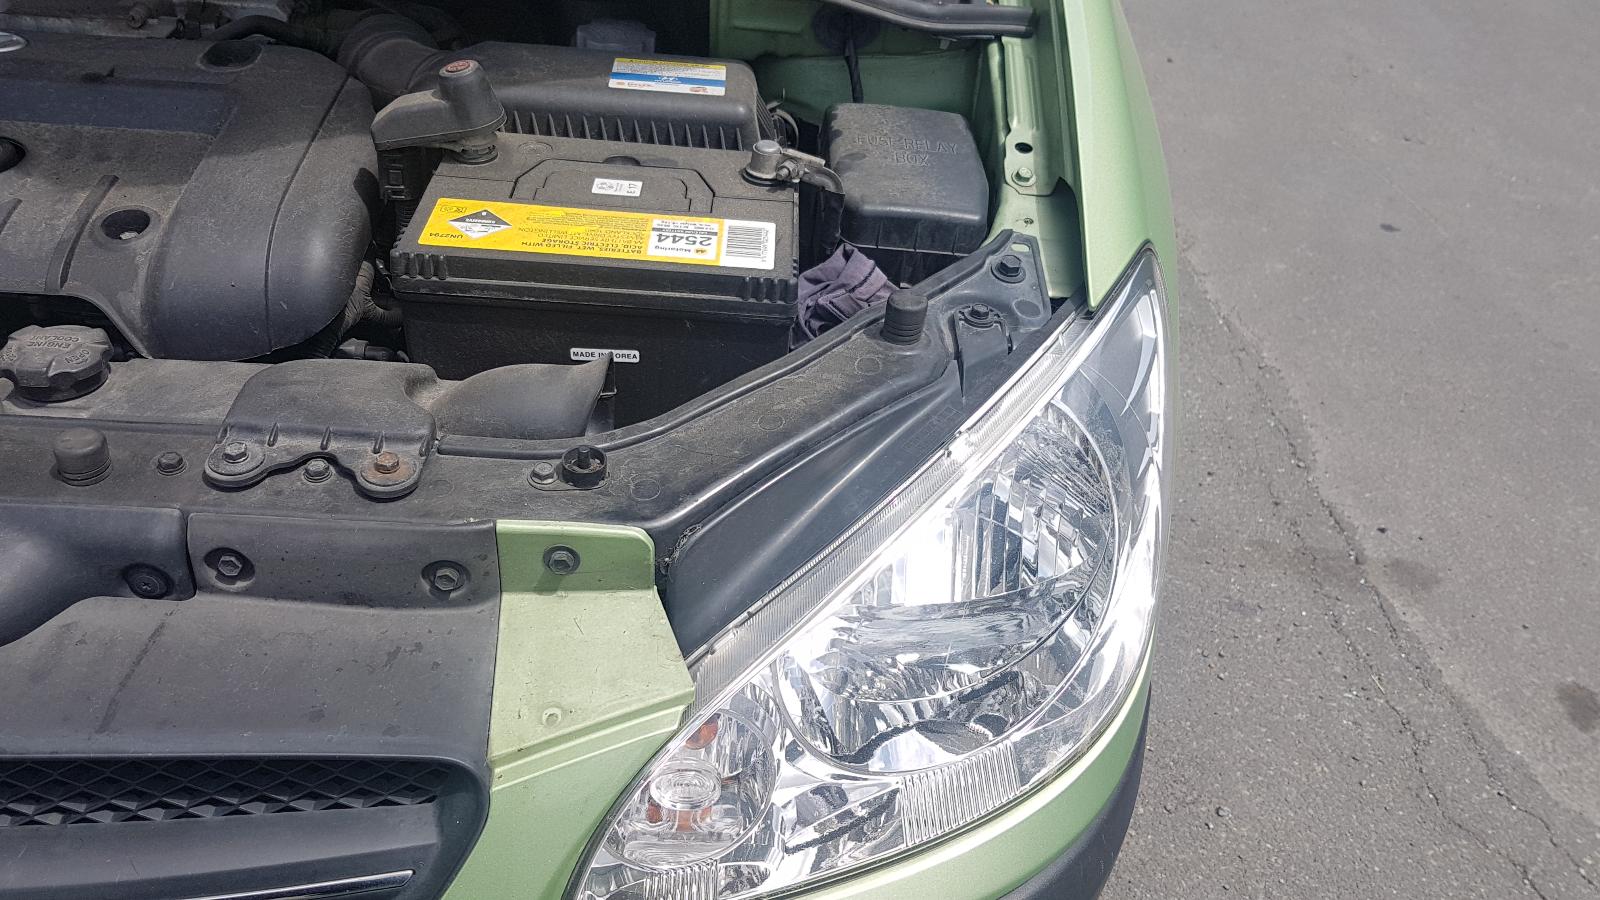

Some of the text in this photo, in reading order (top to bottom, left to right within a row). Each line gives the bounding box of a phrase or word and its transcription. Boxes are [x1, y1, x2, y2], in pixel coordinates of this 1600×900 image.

[854, 134, 957, 154] FUSE RELAY
[894, 152, 929, 167] BOX
[656, 233, 713, 247] 2544
[598, 246, 642, 254] BATTERIES,
[654, 245, 692, 253] Motoring
[26, 340, 72, 349] ENGINE
[29, 335, 80, 343] COOLANT
[63, 349, 90, 364] OPEN
